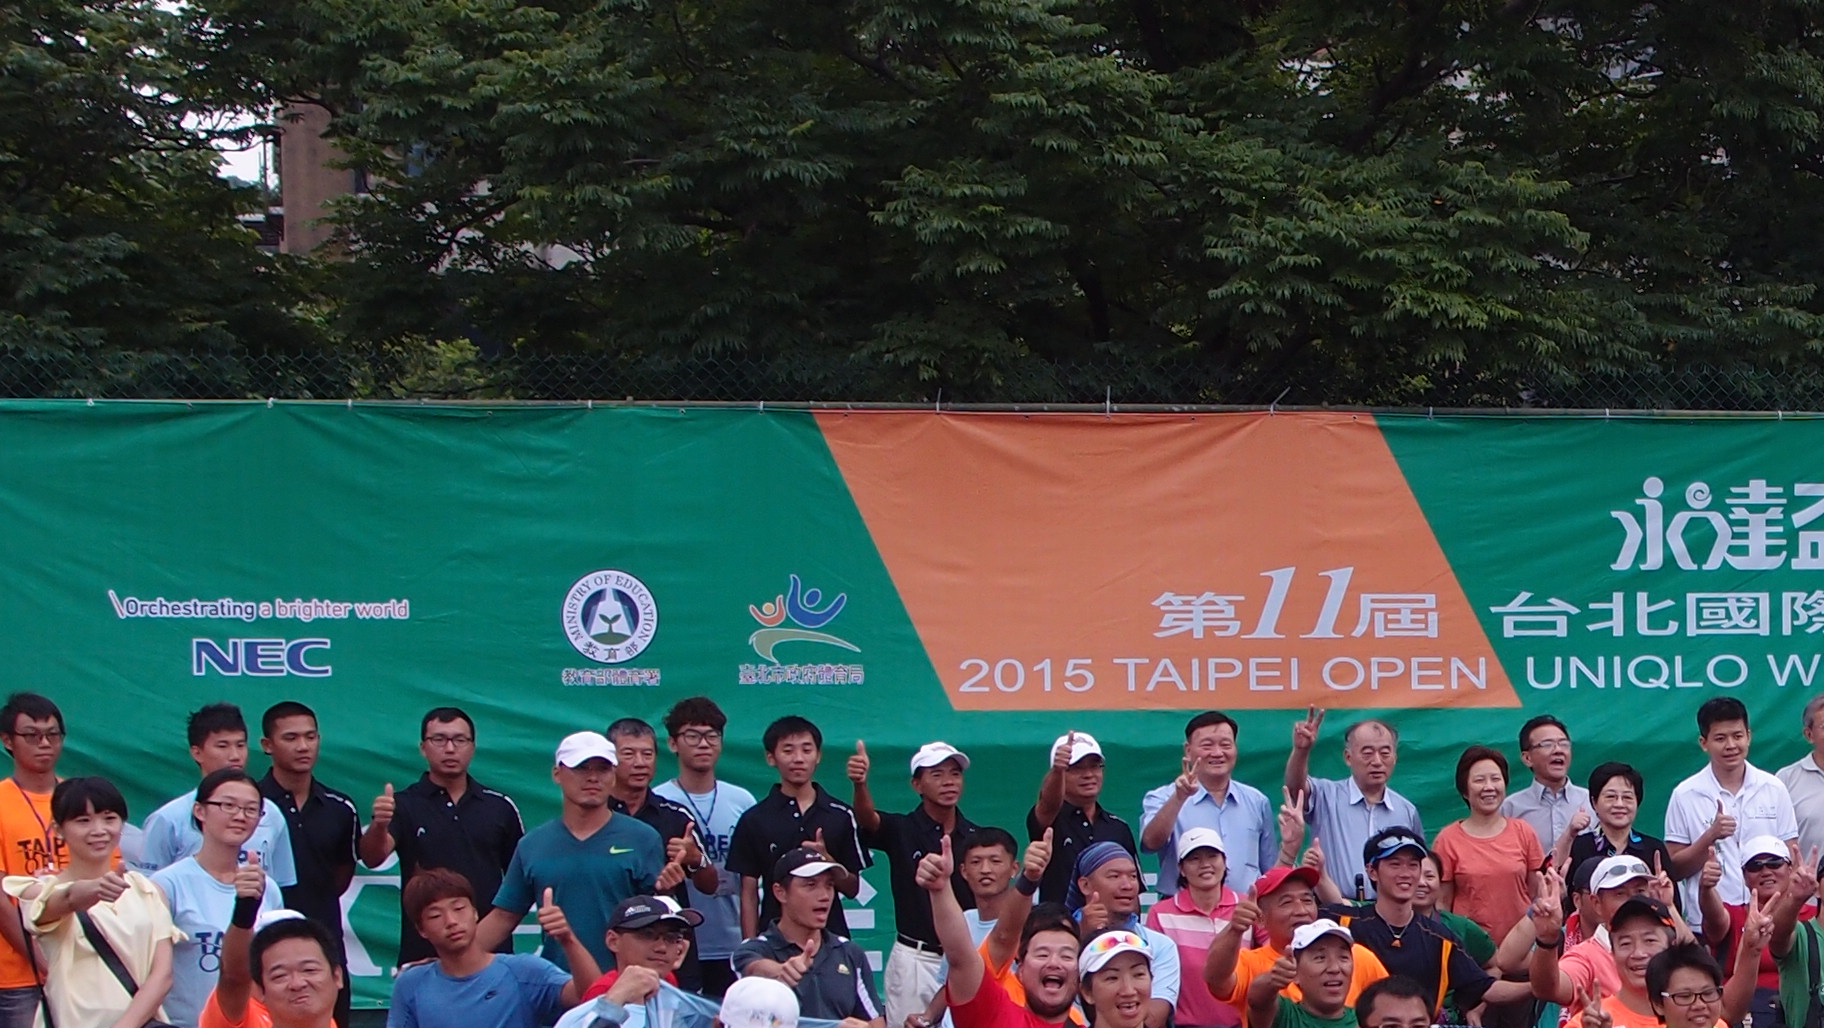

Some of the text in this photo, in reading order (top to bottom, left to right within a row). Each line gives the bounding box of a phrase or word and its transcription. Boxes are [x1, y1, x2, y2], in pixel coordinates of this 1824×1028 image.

[124, 598, 410, 622] Orchestrating a brighter world
[566, 574, 655, 643] MINISTRY OF EDUCATION
[192, 638, 332, 677] NEC
[958, 658, 1096, 693] 2015
[1112, 656, 1300, 692] TAIPEI
[1321, 655, 1488, 691] OPEN
[1526, 654, 1749, 689] UNIQLO
